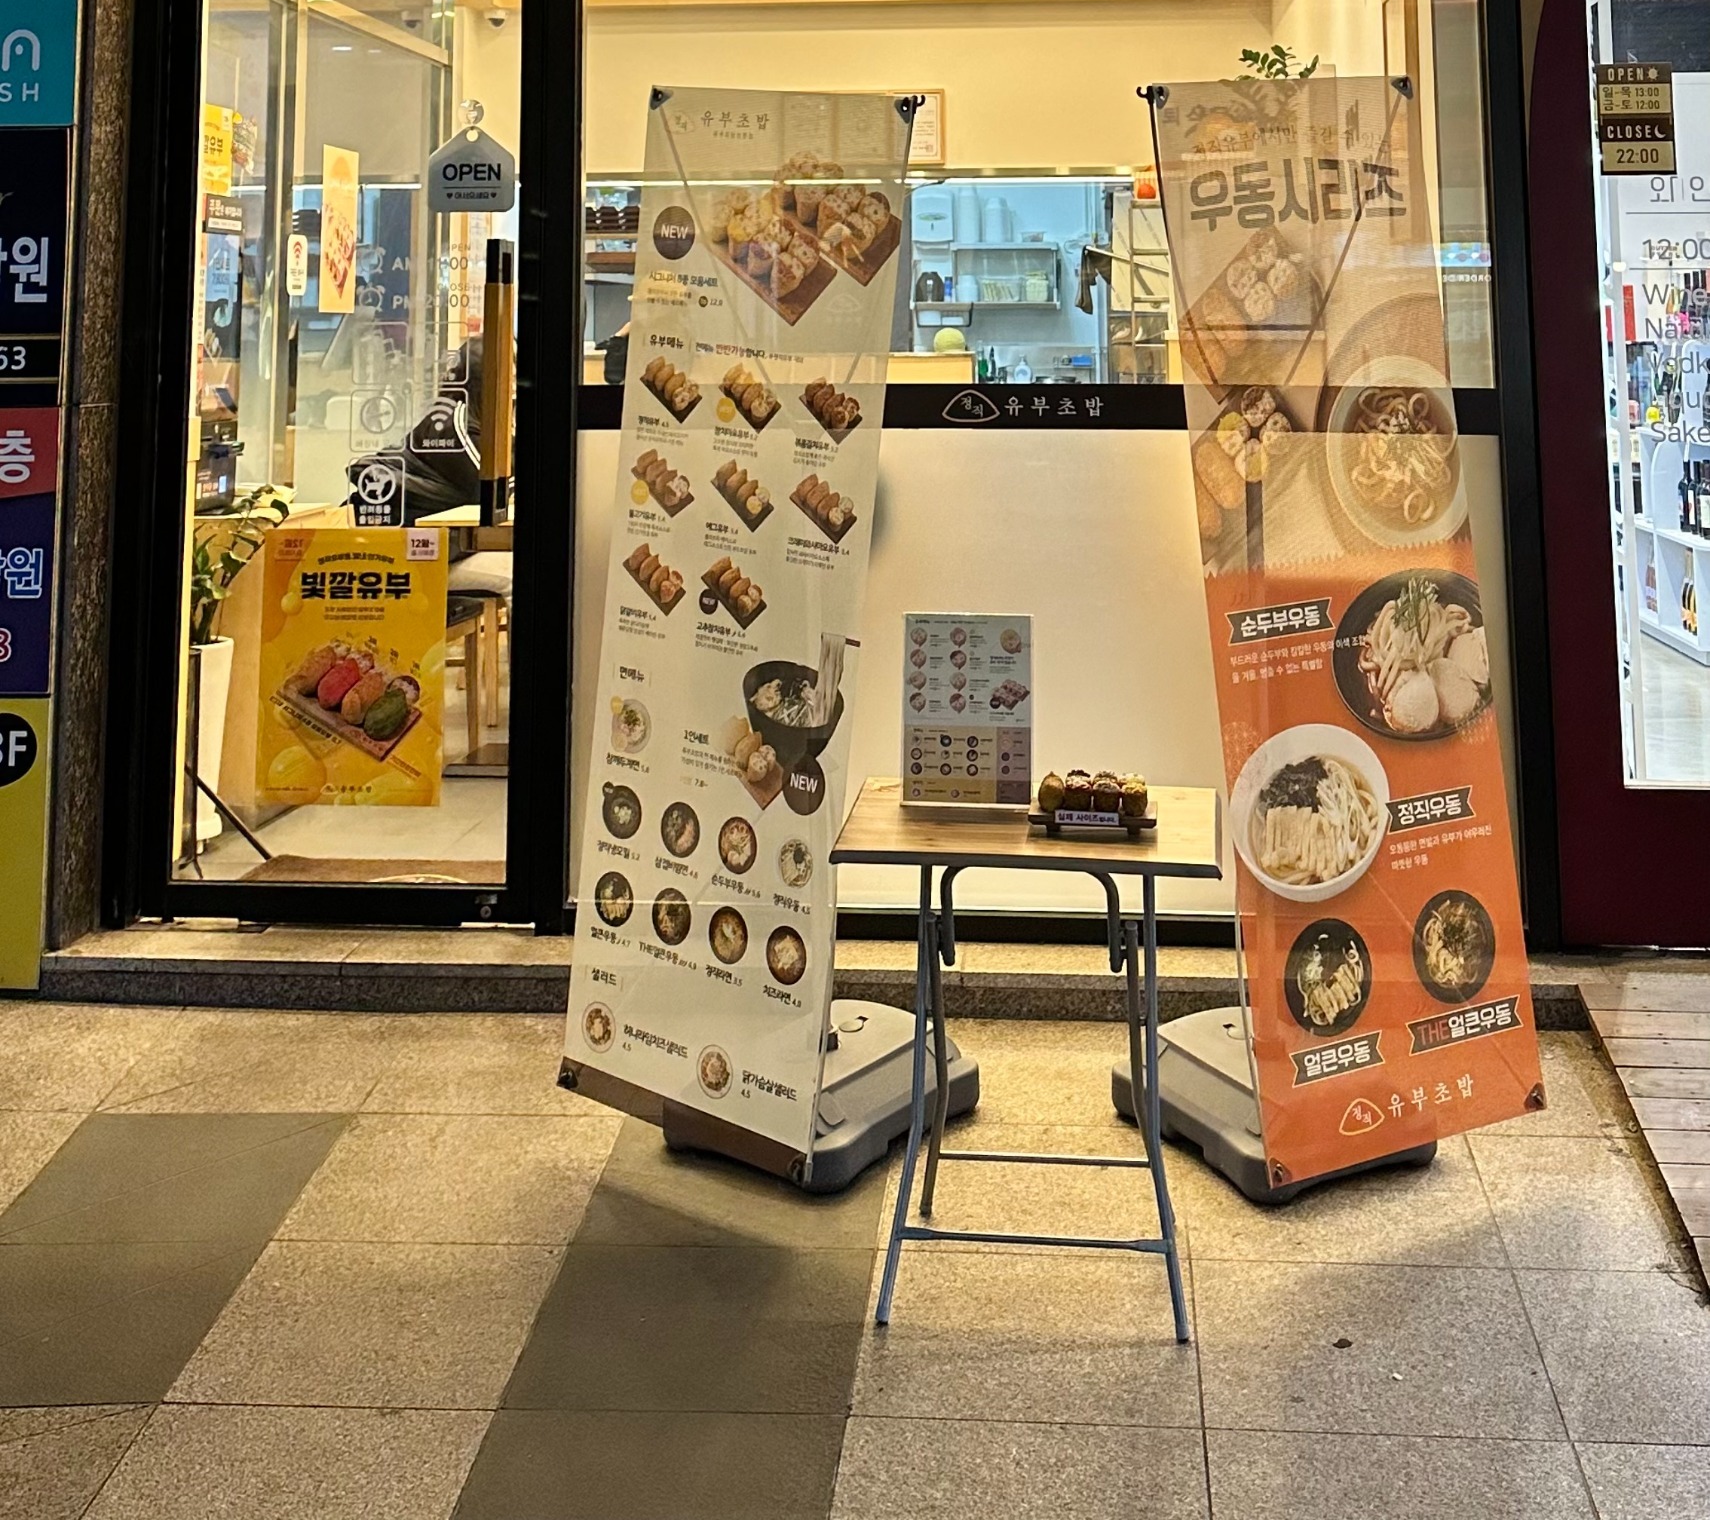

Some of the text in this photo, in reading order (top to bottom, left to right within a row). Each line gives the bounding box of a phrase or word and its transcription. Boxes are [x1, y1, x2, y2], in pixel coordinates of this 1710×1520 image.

[1607, 67, 1644, 81] OPEN
[1602, 86, 1660, 99] 일-목 13:00
[1603, 99, 1660, 112] 금-토 12:00
[700, 110, 771, 131] 유부초밥
[1607, 125, 1652, 139] CLOSE
[1616, 148, 1660, 164] 22:00
[442, 163, 502, 181] OPEN
[1189, 157, 1408, 232] 우동시리즈
[661, 224, 689, 239] NEW
[0, 236, 50, 304] 원
[1641, 283, 1708, 306] Wine
[649, 333, 685, 350] 유부메뉴
[960, 395, 1104, 418] 정직 유부초밥
[1650, 420, 1710, 443] Sake
[422, 438, 455, 448] 와이파이
[0, 430, 35, 483] 층
[0, 546, 44, 599] 원
[301, 571, 412, 600] 빛깔유부
[1240, 605, 1320, 638] 순두부우동
[1229, 651, 1259, 667] 부드러운
[1260, 648, 1289, 663] 순두부와
[1313, 639, 1335, 654] 우동의
[1335, 637, 1351, 649] 이색
[619, 665, 645, 683] 면메뉴
[683, 729, 710, 746] 1인세트
[0, 729, 28, 768] F
[789, 772, 818, 794] NEW
[1397, 793, 1463, 826] 정직우동
[1441, 830, 1463, 845] 유부가
[1463, 824, 1493, 839] 어우러진
[1413, 853, 1429, 866] 우동
[711, 873, 745, 894] 순두부우동
[773, 892, 800, 913] 정직우동
[590, 926, 617, 945] 얼큰우동
[705, 964, 733, 984] 정직라면
[762, 984, 792, 1005] 치즈라면
[1416, 1002, 1513, 1047] THE얼큰우동
[1303, 1039, 1371, 1078] 얼큰우동
[1351, 1073, 1474, 1126] 정직 유부초밥
